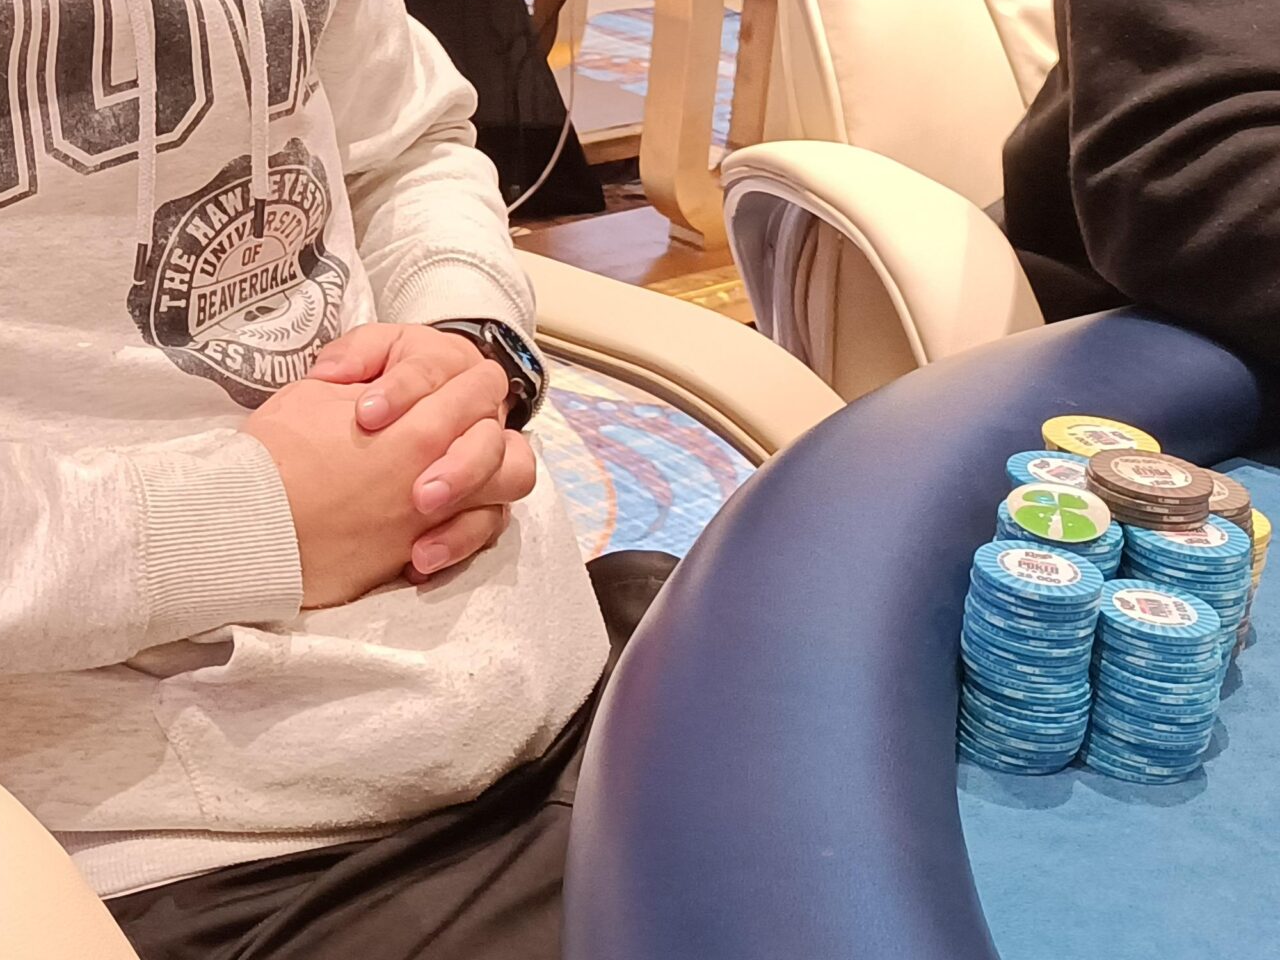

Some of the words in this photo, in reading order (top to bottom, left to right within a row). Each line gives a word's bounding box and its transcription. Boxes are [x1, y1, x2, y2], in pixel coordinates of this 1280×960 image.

[241, 243, 263, 268] OF
[159, 248, 197, 313] THE
[196, 252, 298, 329] BEAVERDALE
[204, 339, 244, 370] ES
